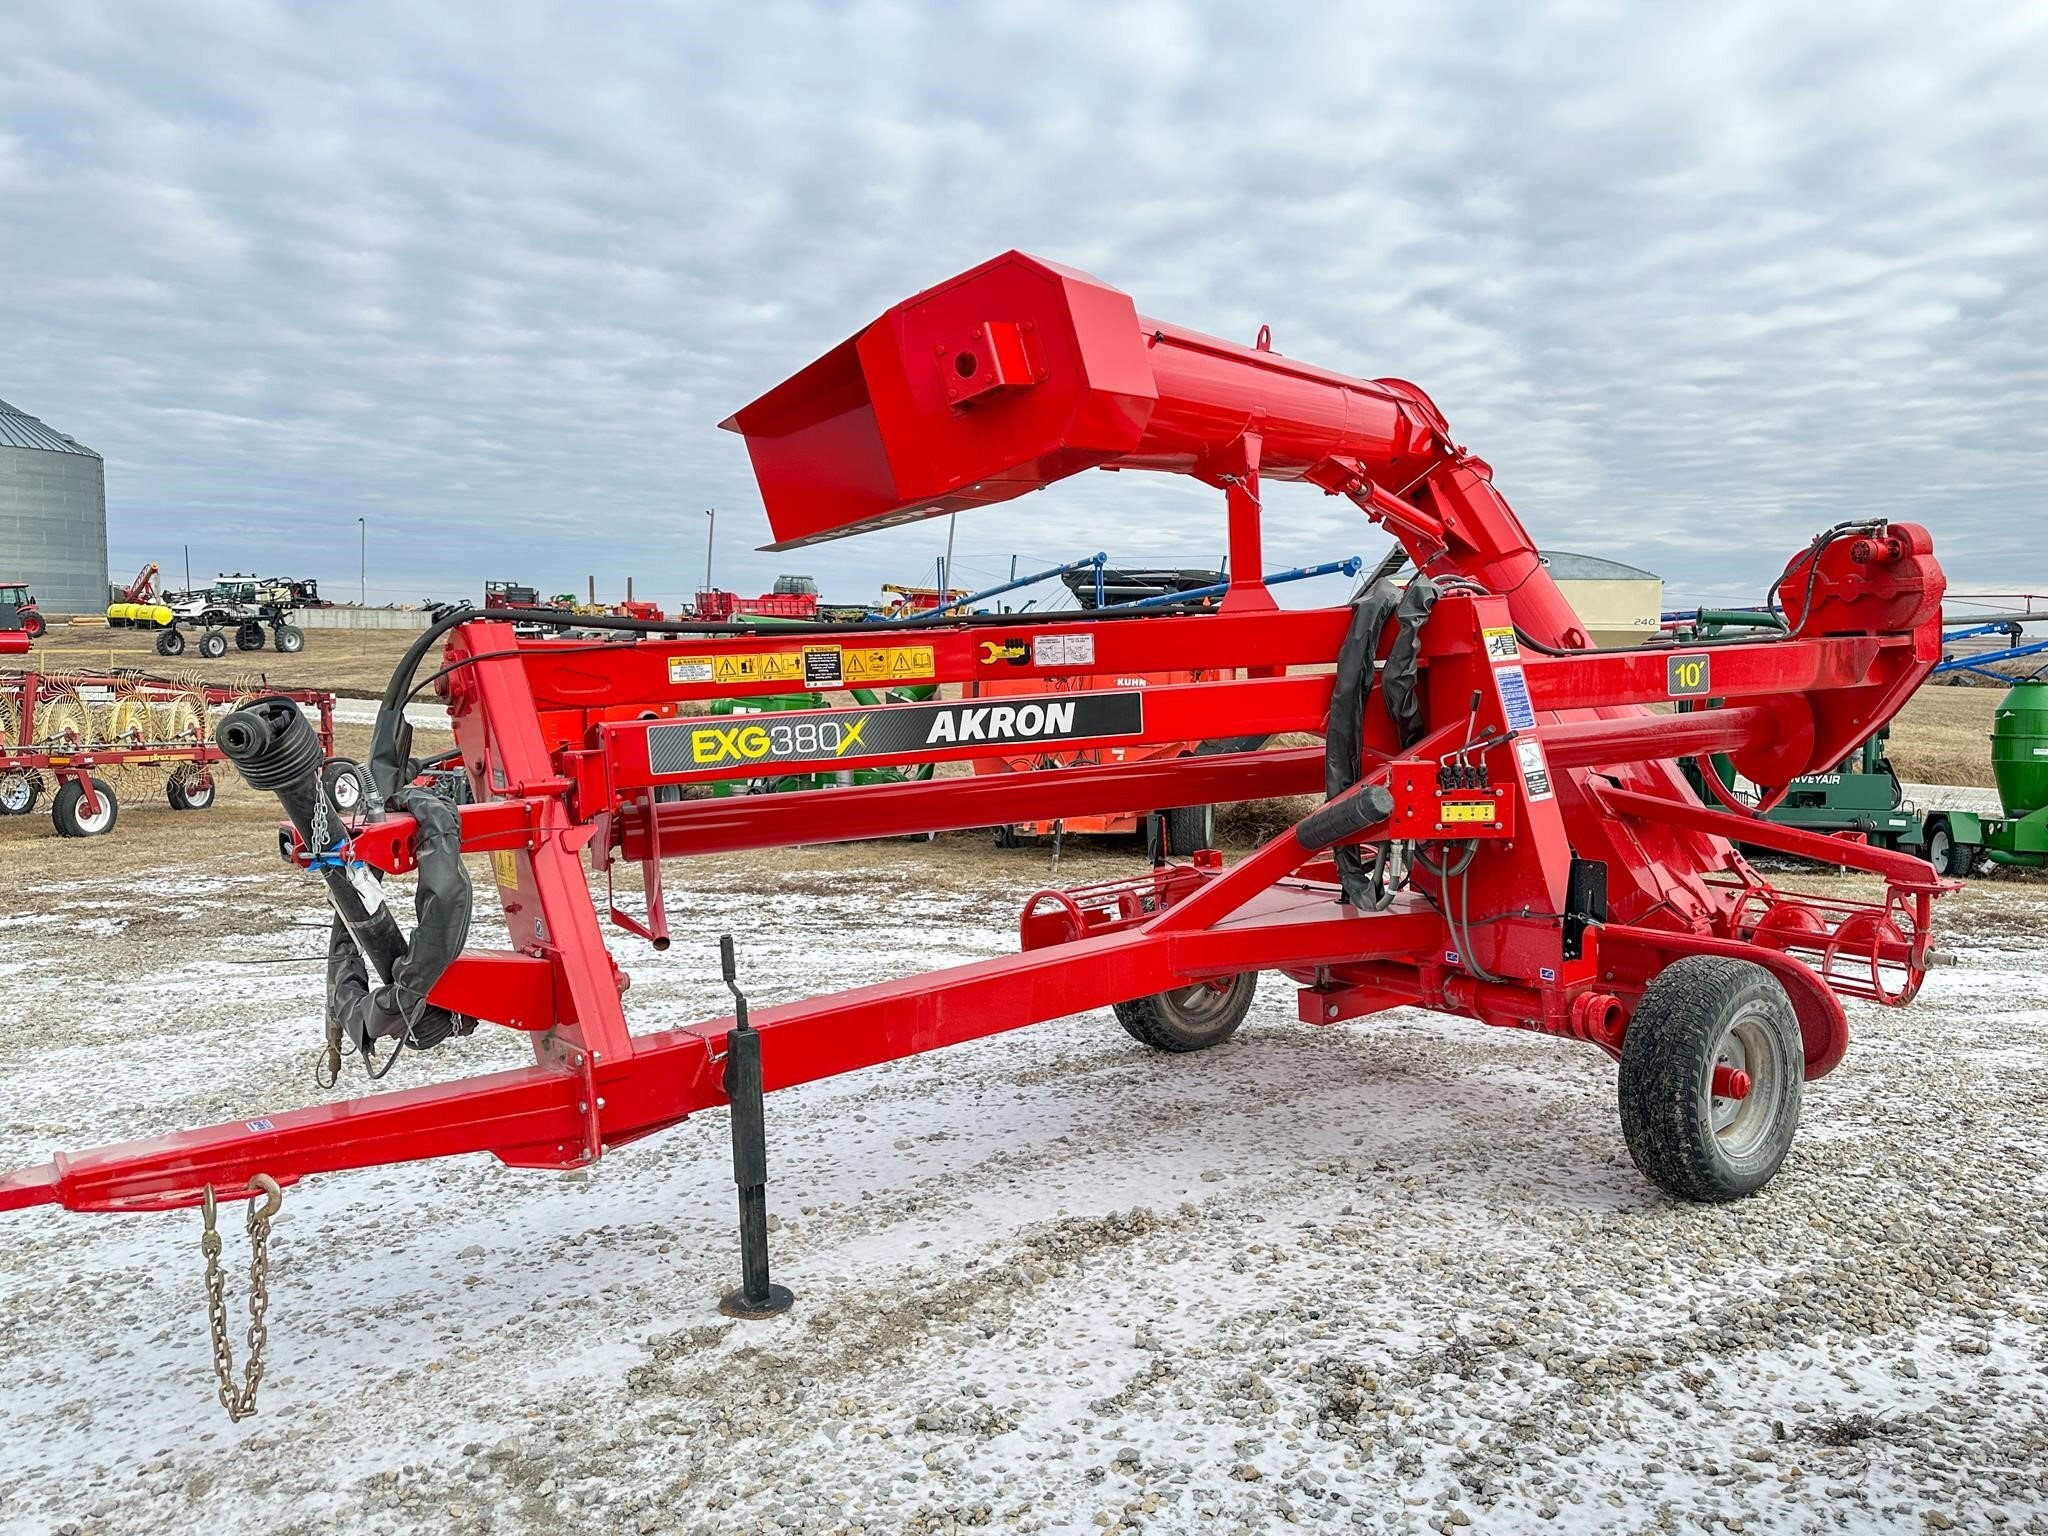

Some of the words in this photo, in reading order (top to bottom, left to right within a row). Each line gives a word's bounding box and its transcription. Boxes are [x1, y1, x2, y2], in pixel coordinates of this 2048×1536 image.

[804, 506, 944, 543] AKRON
[1634, 618, 1656, 626] 240
[1117, 678, 1147, 687] KUHN
[691, 713, 871, 763] EXG380X
[925, 702, 1076, 744] AKRON
